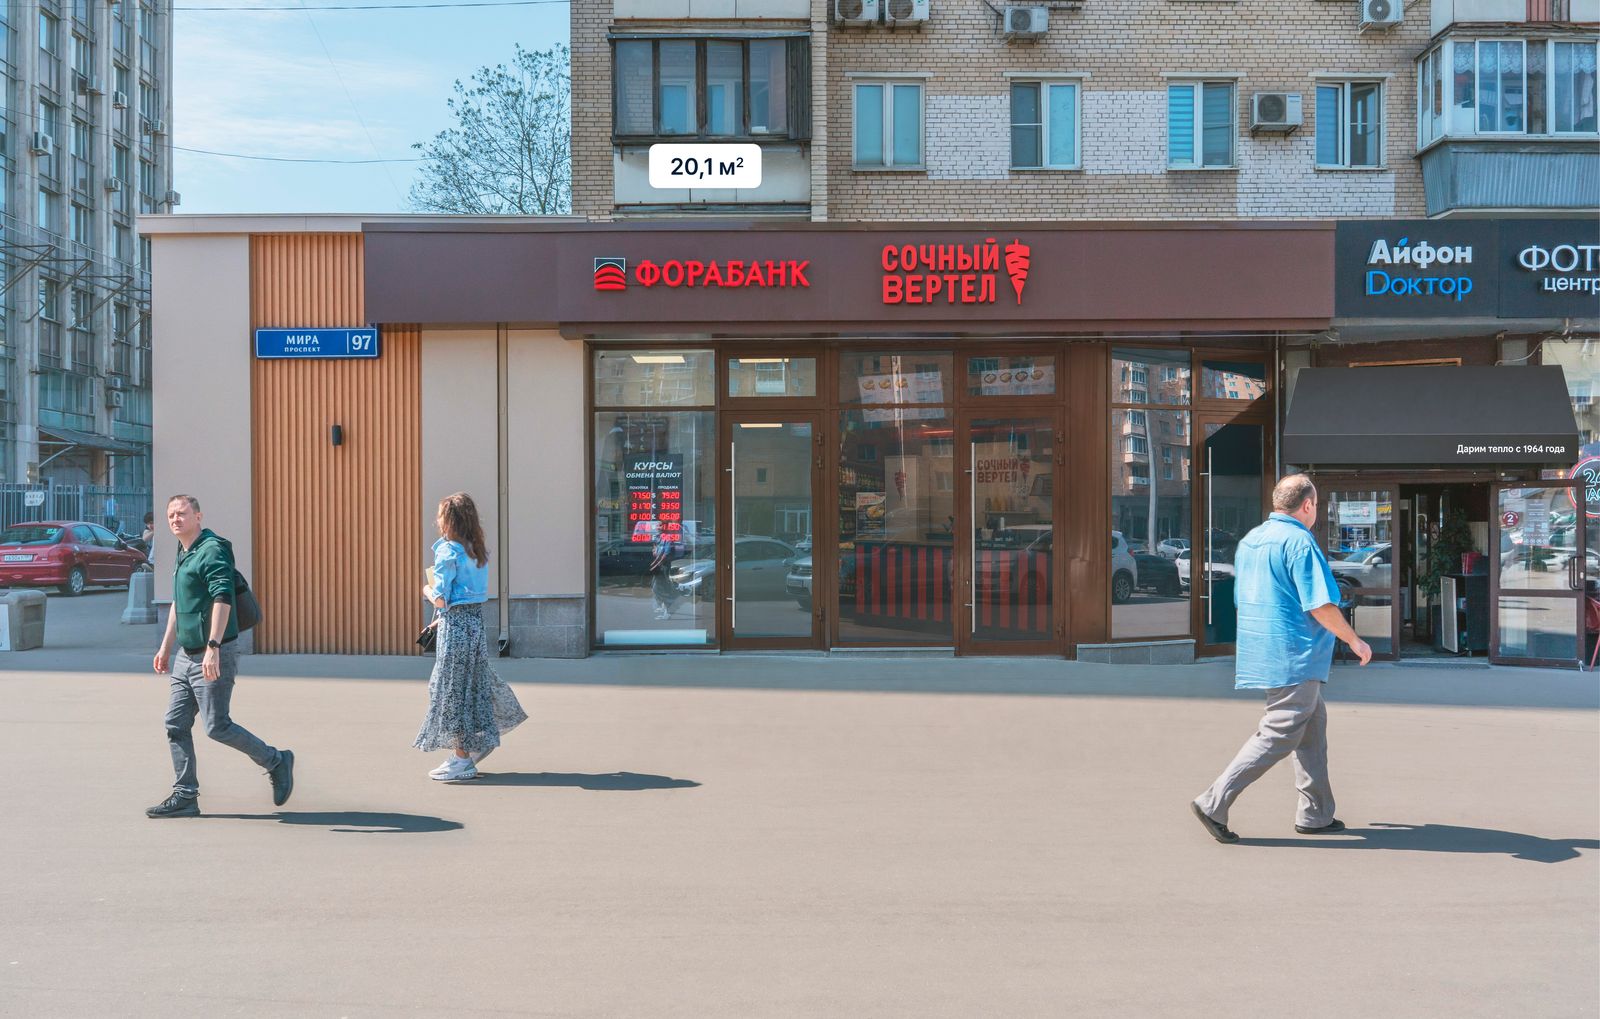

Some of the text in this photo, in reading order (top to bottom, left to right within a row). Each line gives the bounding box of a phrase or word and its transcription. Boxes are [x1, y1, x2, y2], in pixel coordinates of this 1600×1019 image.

[881, 238, 999, 271] СОЧНЫЙ
[1367, 236, 1472, 269] Айфон
[1519, 244, 1600, 272] ФОТ
[635, 260, 810, 287] ФОРАБАНК
[882, 274, 996, 304] ВЕРТЕЛ
[286, 335, 319, 345] МИРА
[351, 335, 372, 350] 97
[1456, 444, 1486, 454] Дарим
[1523, 445, 1543, 453] 1964
[1545, 446, 1565, 454] года
[633, 462, 673, 470] КУРСЫ
[977, 457, 1018, 471] СОЧНЫЙ
[977, 471, 1017, 483] ВЕРТЕЛ
